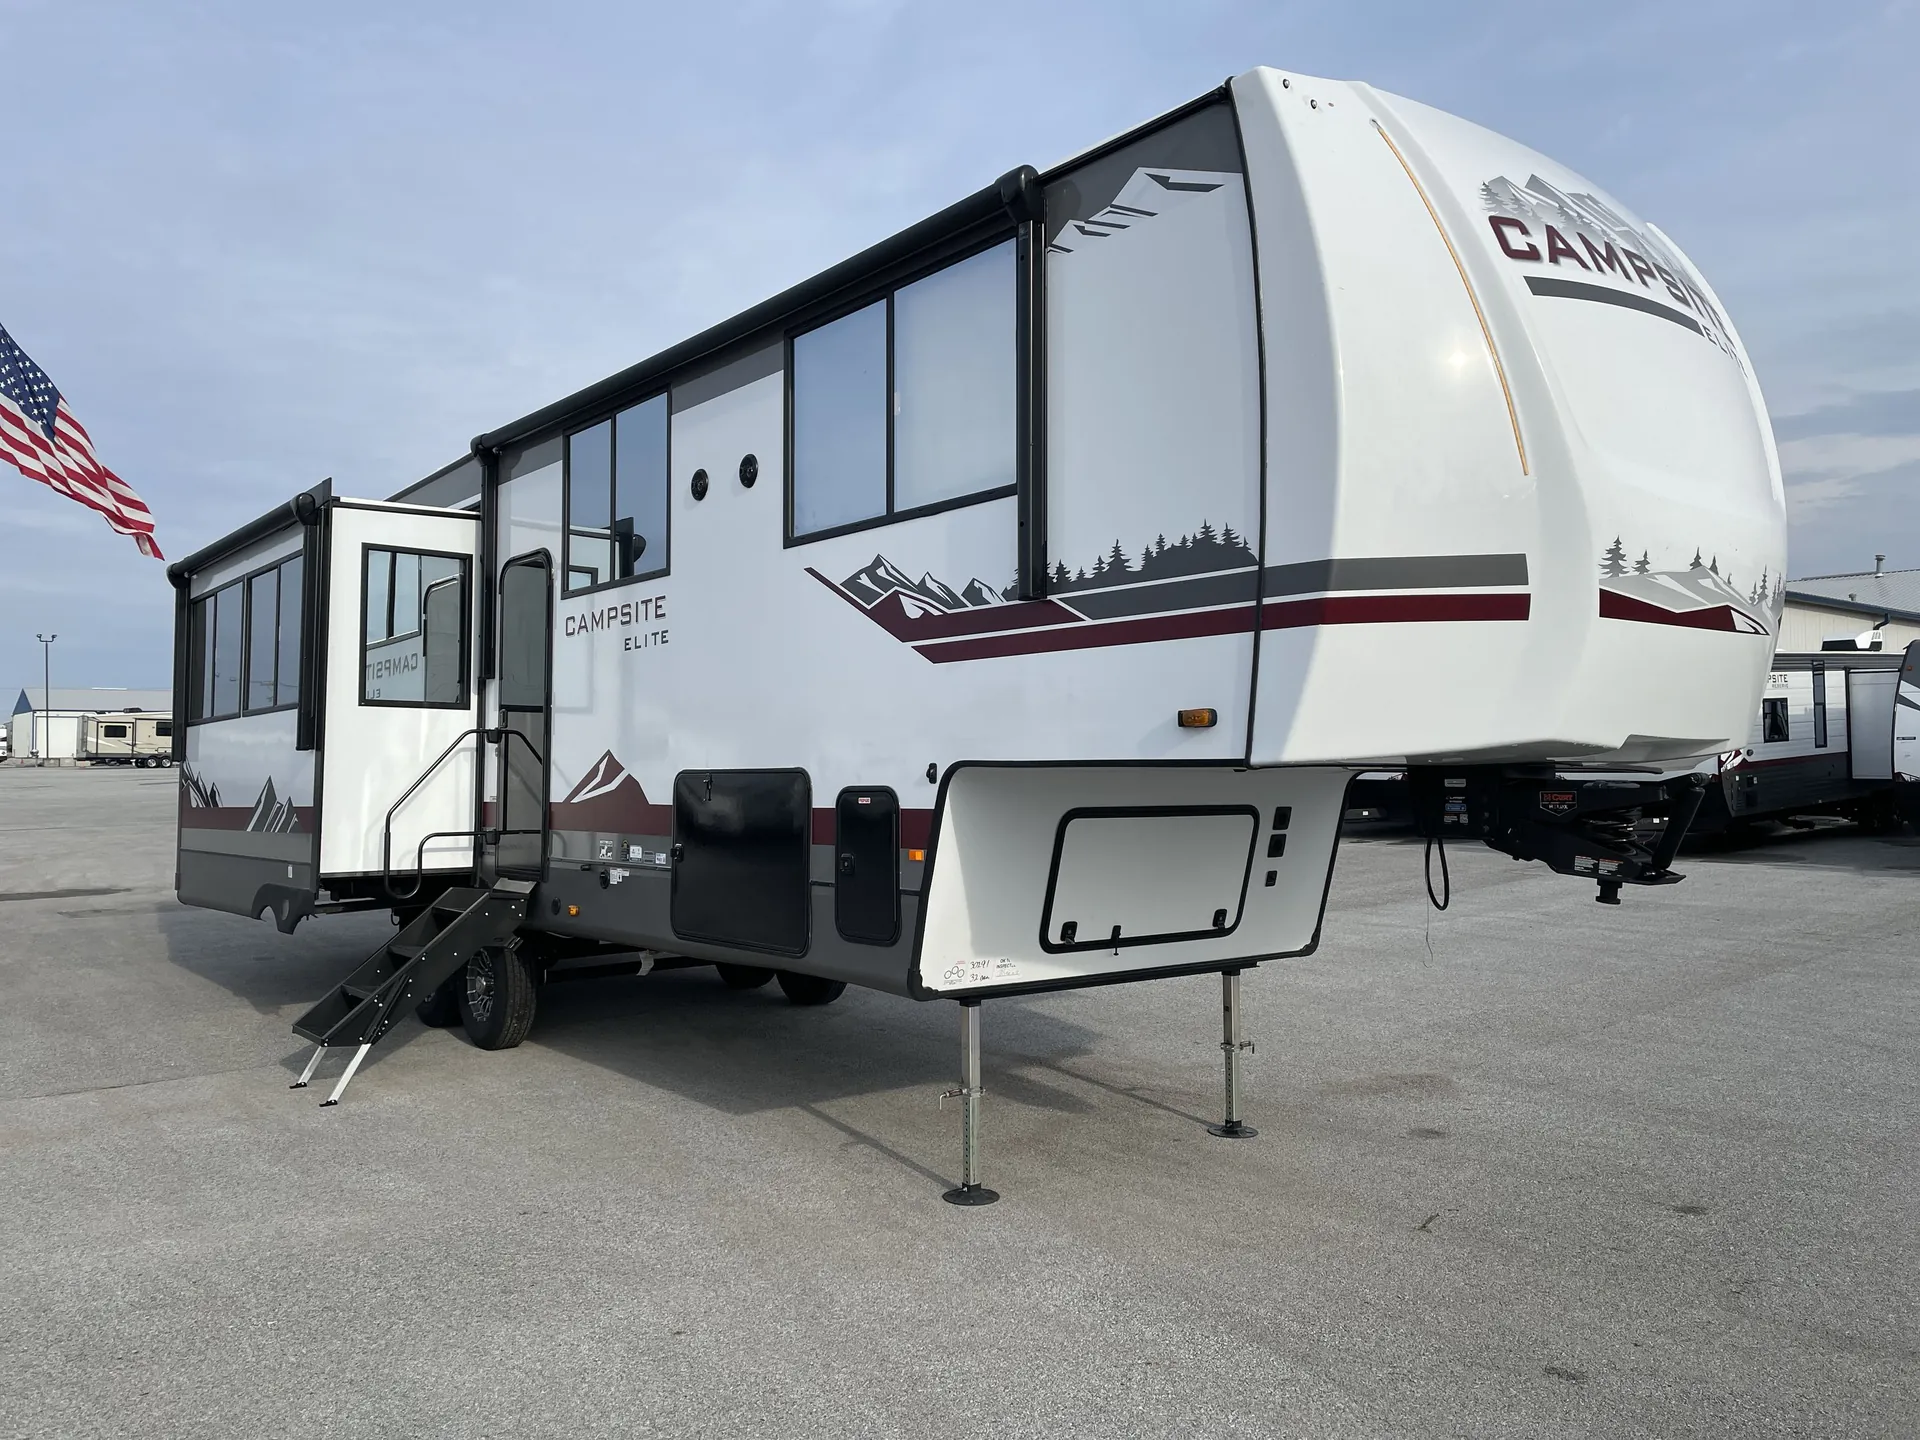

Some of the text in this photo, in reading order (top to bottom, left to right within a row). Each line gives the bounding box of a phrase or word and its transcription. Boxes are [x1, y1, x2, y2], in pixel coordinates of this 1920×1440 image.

[1488, 215, 1737, 350] CAMPSITE
[565, 595, 666, 637] CAMPSITE
[624, 630, 669, 651] ELITE
[1767, 674, 1788, 683] PSITE
